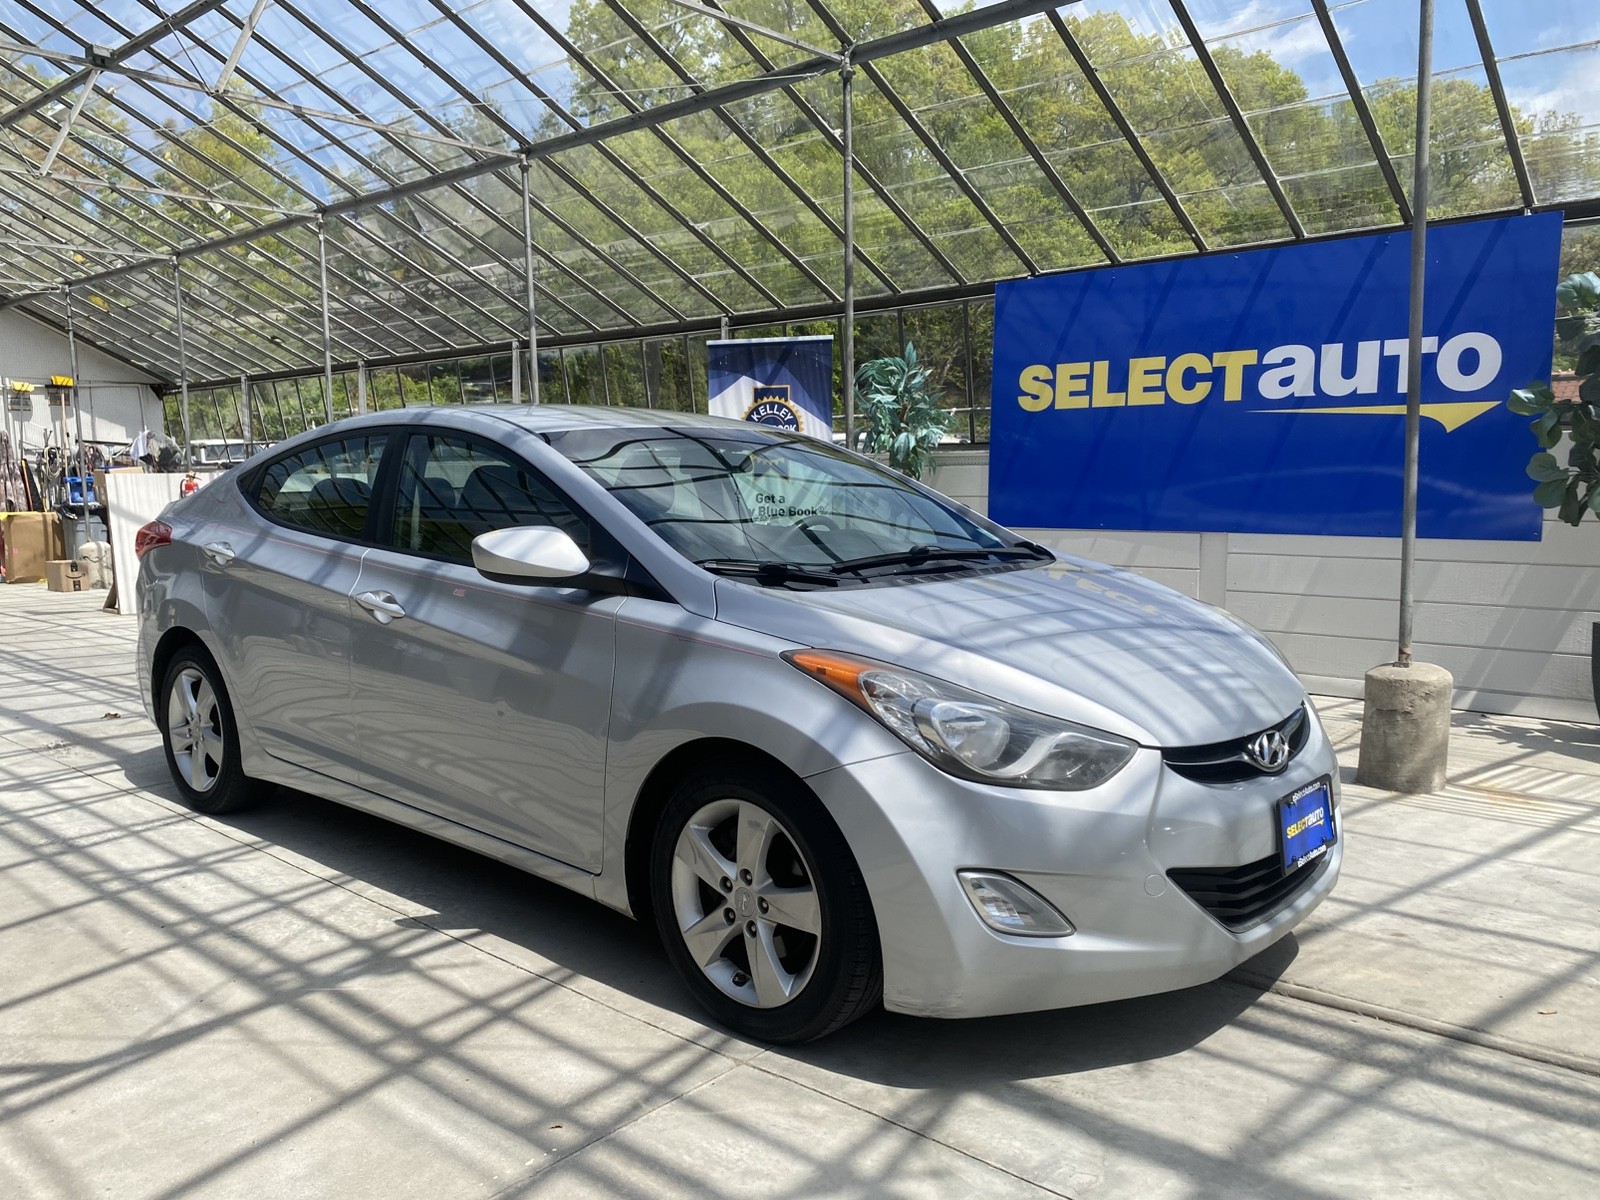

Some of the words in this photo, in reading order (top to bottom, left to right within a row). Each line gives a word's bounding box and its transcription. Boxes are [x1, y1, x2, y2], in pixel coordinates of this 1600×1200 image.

[751, 404, 794, 422] KELLEY
[755, 493, 776, 504] Get
[778, 495, 786, 504] a
[758, 505, 786, 517] Blue
